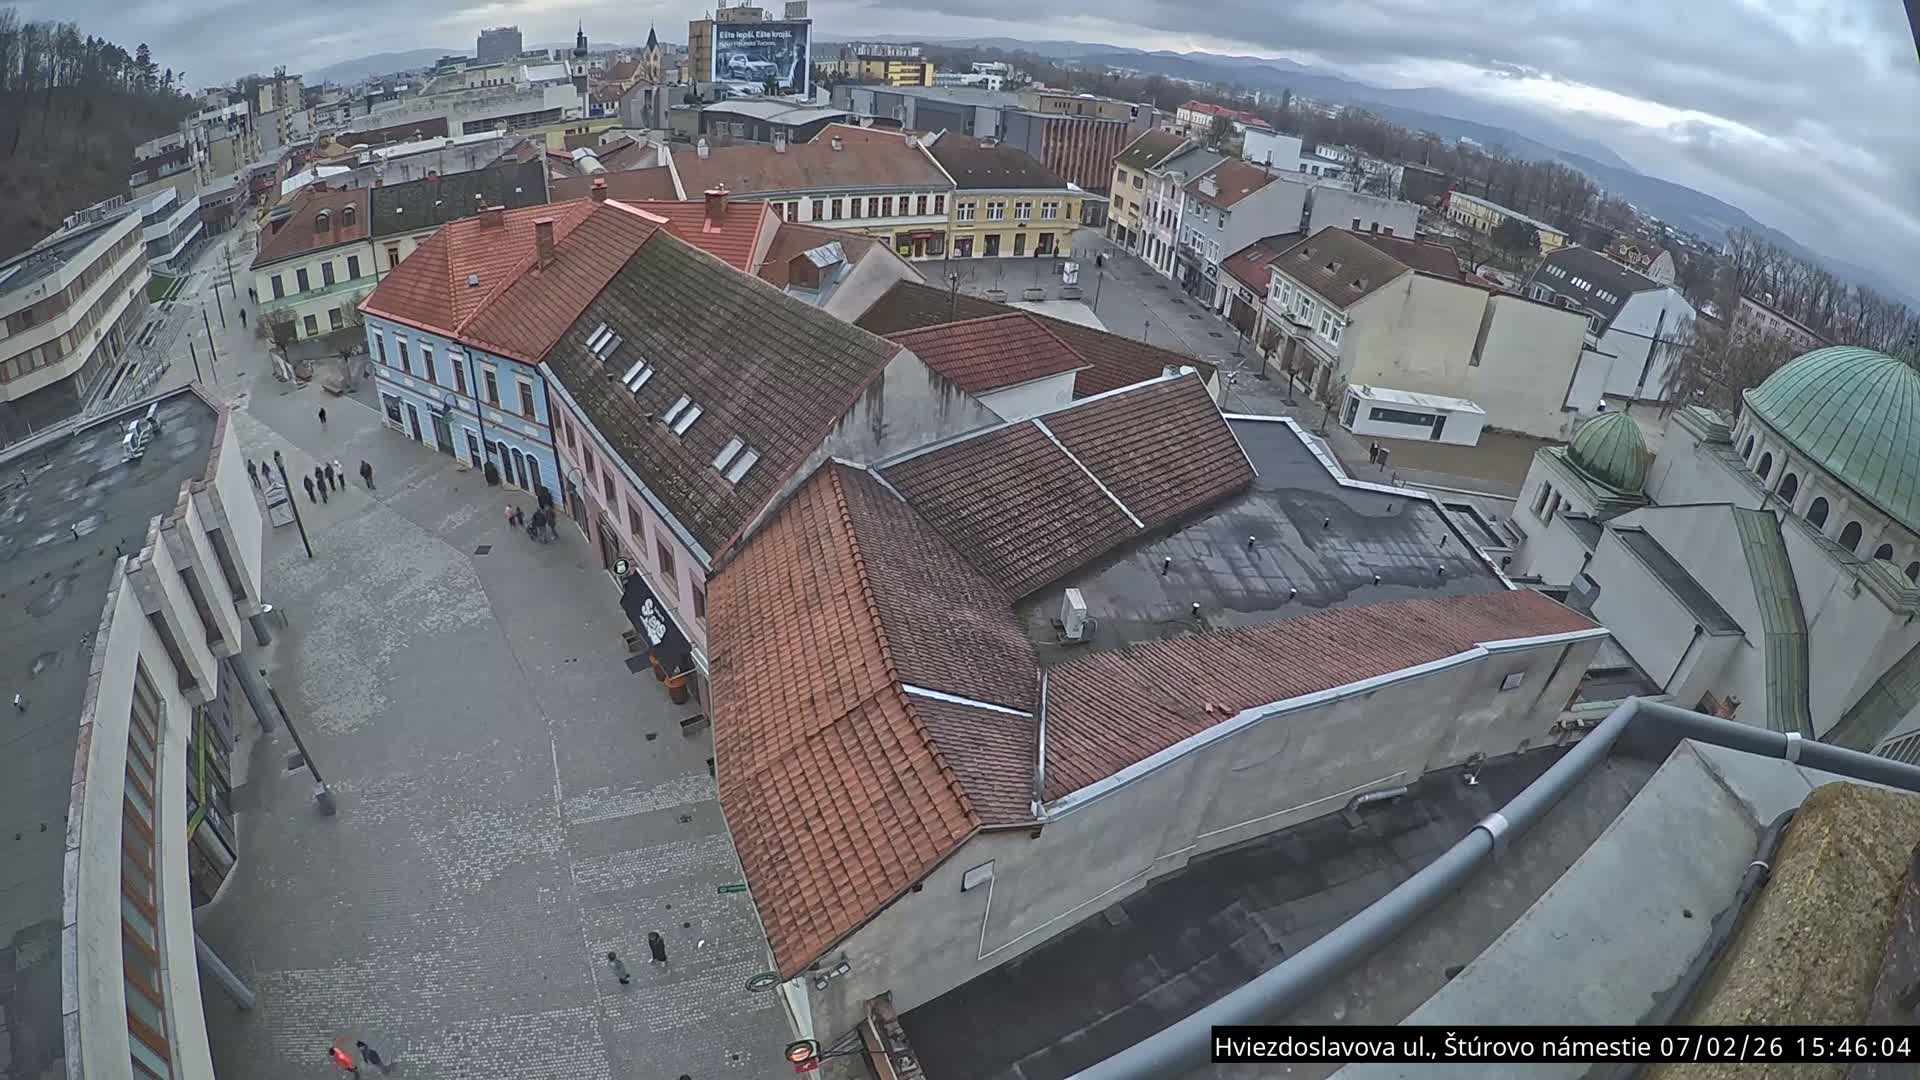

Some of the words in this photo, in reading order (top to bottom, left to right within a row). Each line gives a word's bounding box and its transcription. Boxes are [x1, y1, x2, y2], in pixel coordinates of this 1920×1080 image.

[720, 31, 735, 39] Ešte
[736, 31, 755, 40] lepší.
[756, 31, 771, 39] Ešte
[772, 31, 793, 39] krajší.
